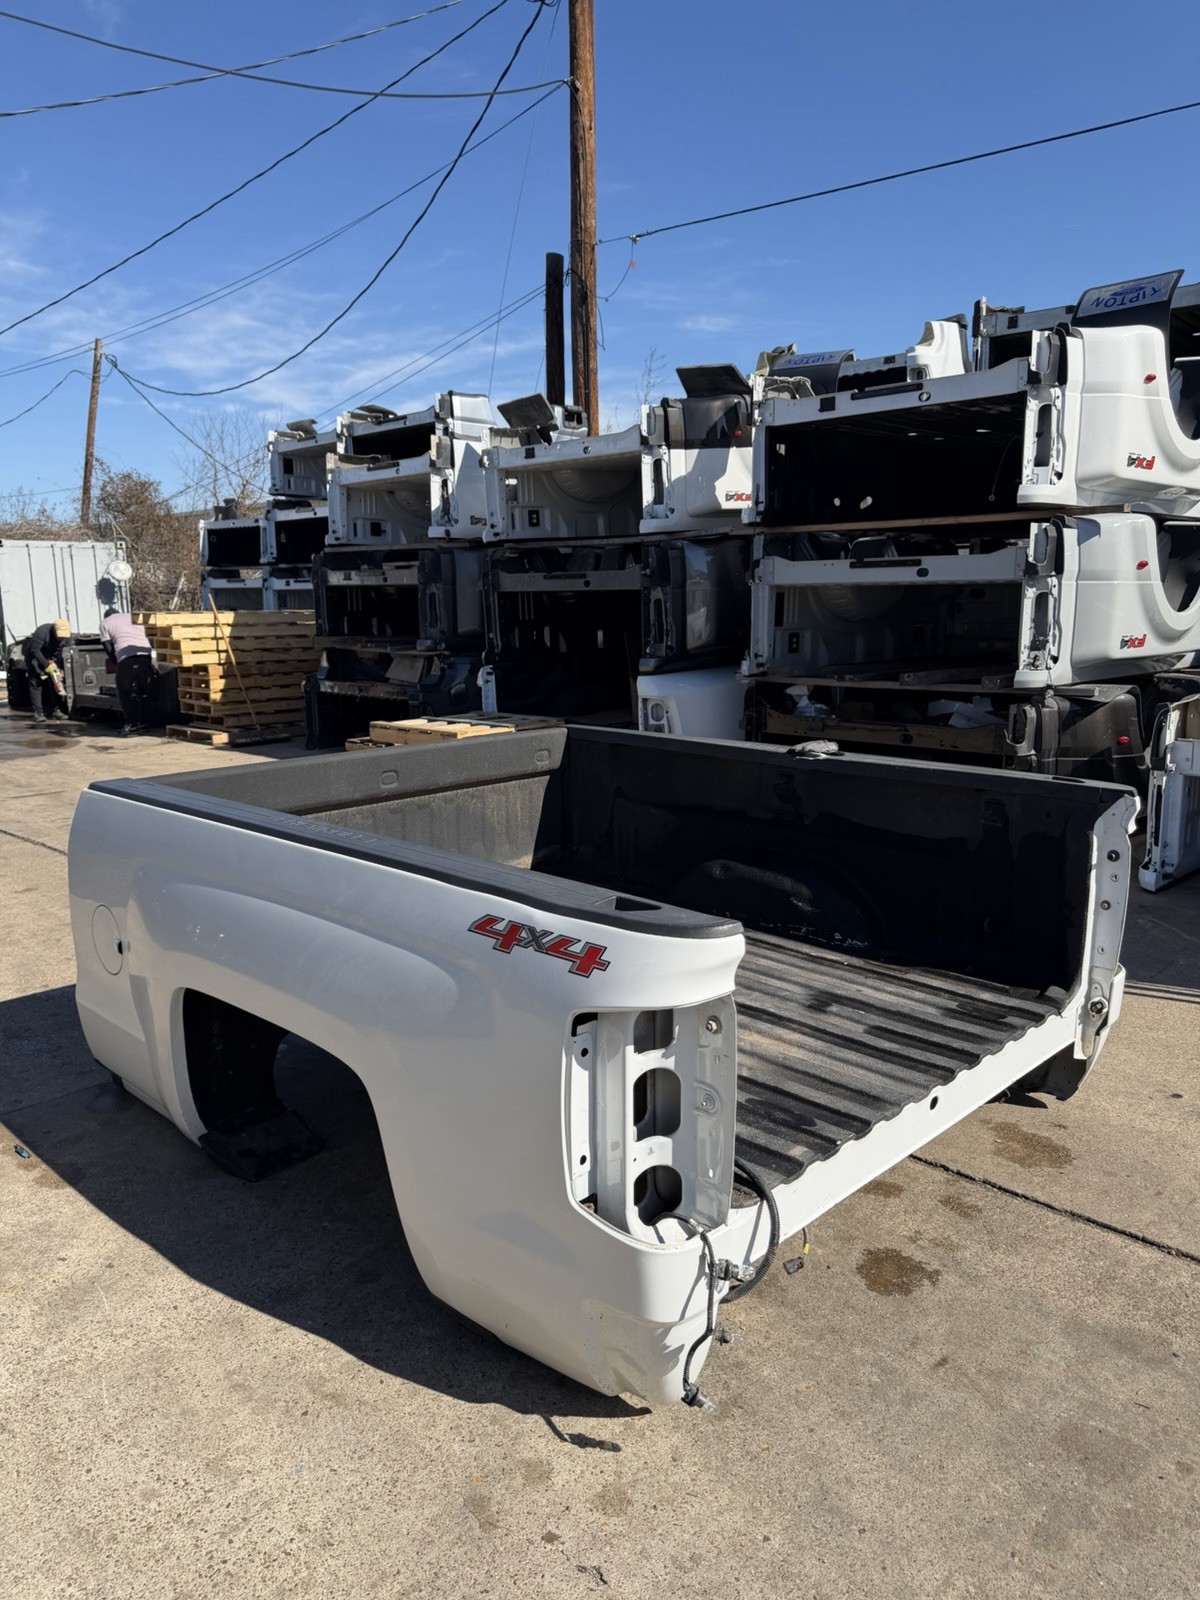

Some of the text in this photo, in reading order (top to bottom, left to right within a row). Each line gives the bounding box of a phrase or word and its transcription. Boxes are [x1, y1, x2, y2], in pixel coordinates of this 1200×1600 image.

[1091, 286, 1162, 308] TIPTON
[1126, 455, 1156, 470] FX4
[1119, 633, 1147, 650] FX4
